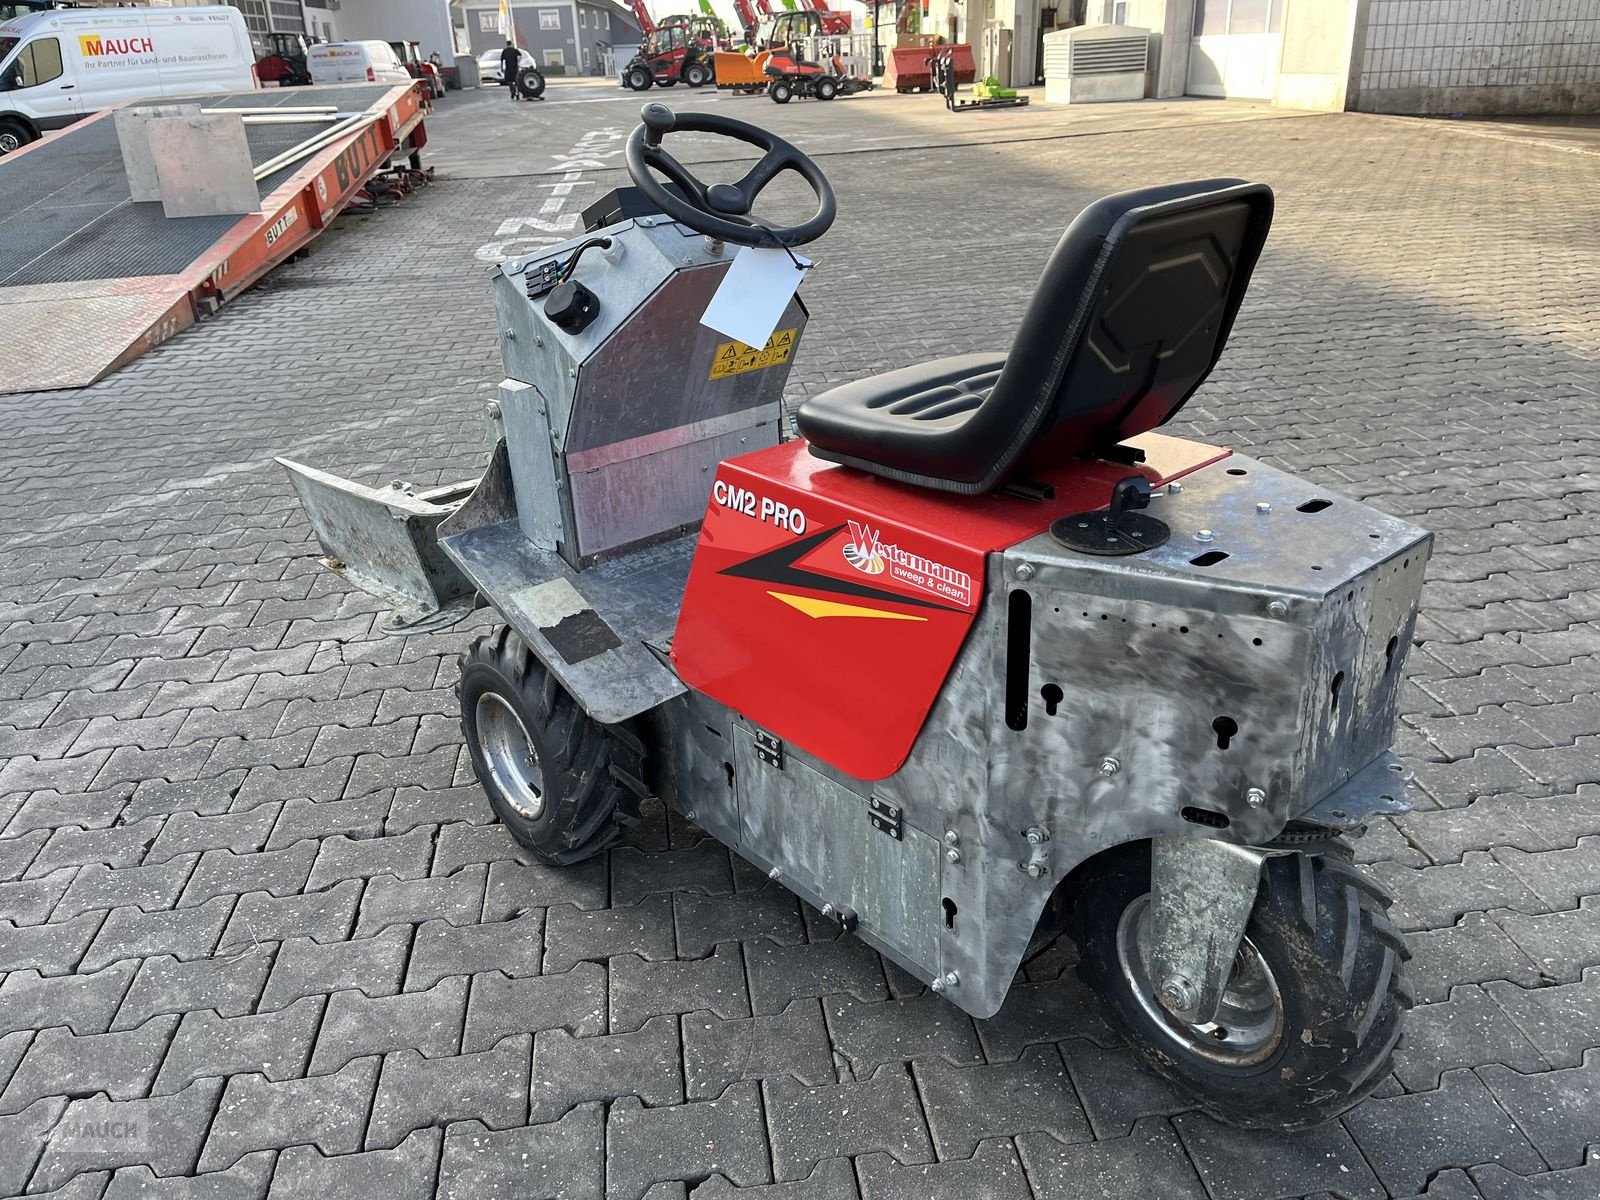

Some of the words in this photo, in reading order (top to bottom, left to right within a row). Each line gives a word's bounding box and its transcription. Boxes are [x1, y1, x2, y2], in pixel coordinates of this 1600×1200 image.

[84, 61, 96, 69] Ihr
[97, 59, 126, 68] Partner
[127, 57, 139, 66] für
[140, 56, 161, 66] Land-
[162, 55, 177, 64] und
[178, 53, 228, 63] Baumaschinen
[86, 37, 154, 56] MAUCH
[334, 124, 380, 193] BUTT
[266, 215, 288, 244] BUTT
[713, 480, 757, 518] CM2
[761, 496, 807, 535] PRO
[847, 519, 970, 590] Westermann
[893, 565, 926, 588] sweep
[926, 576, 935, 588] &
[936, 580, 967, 601] clean.
